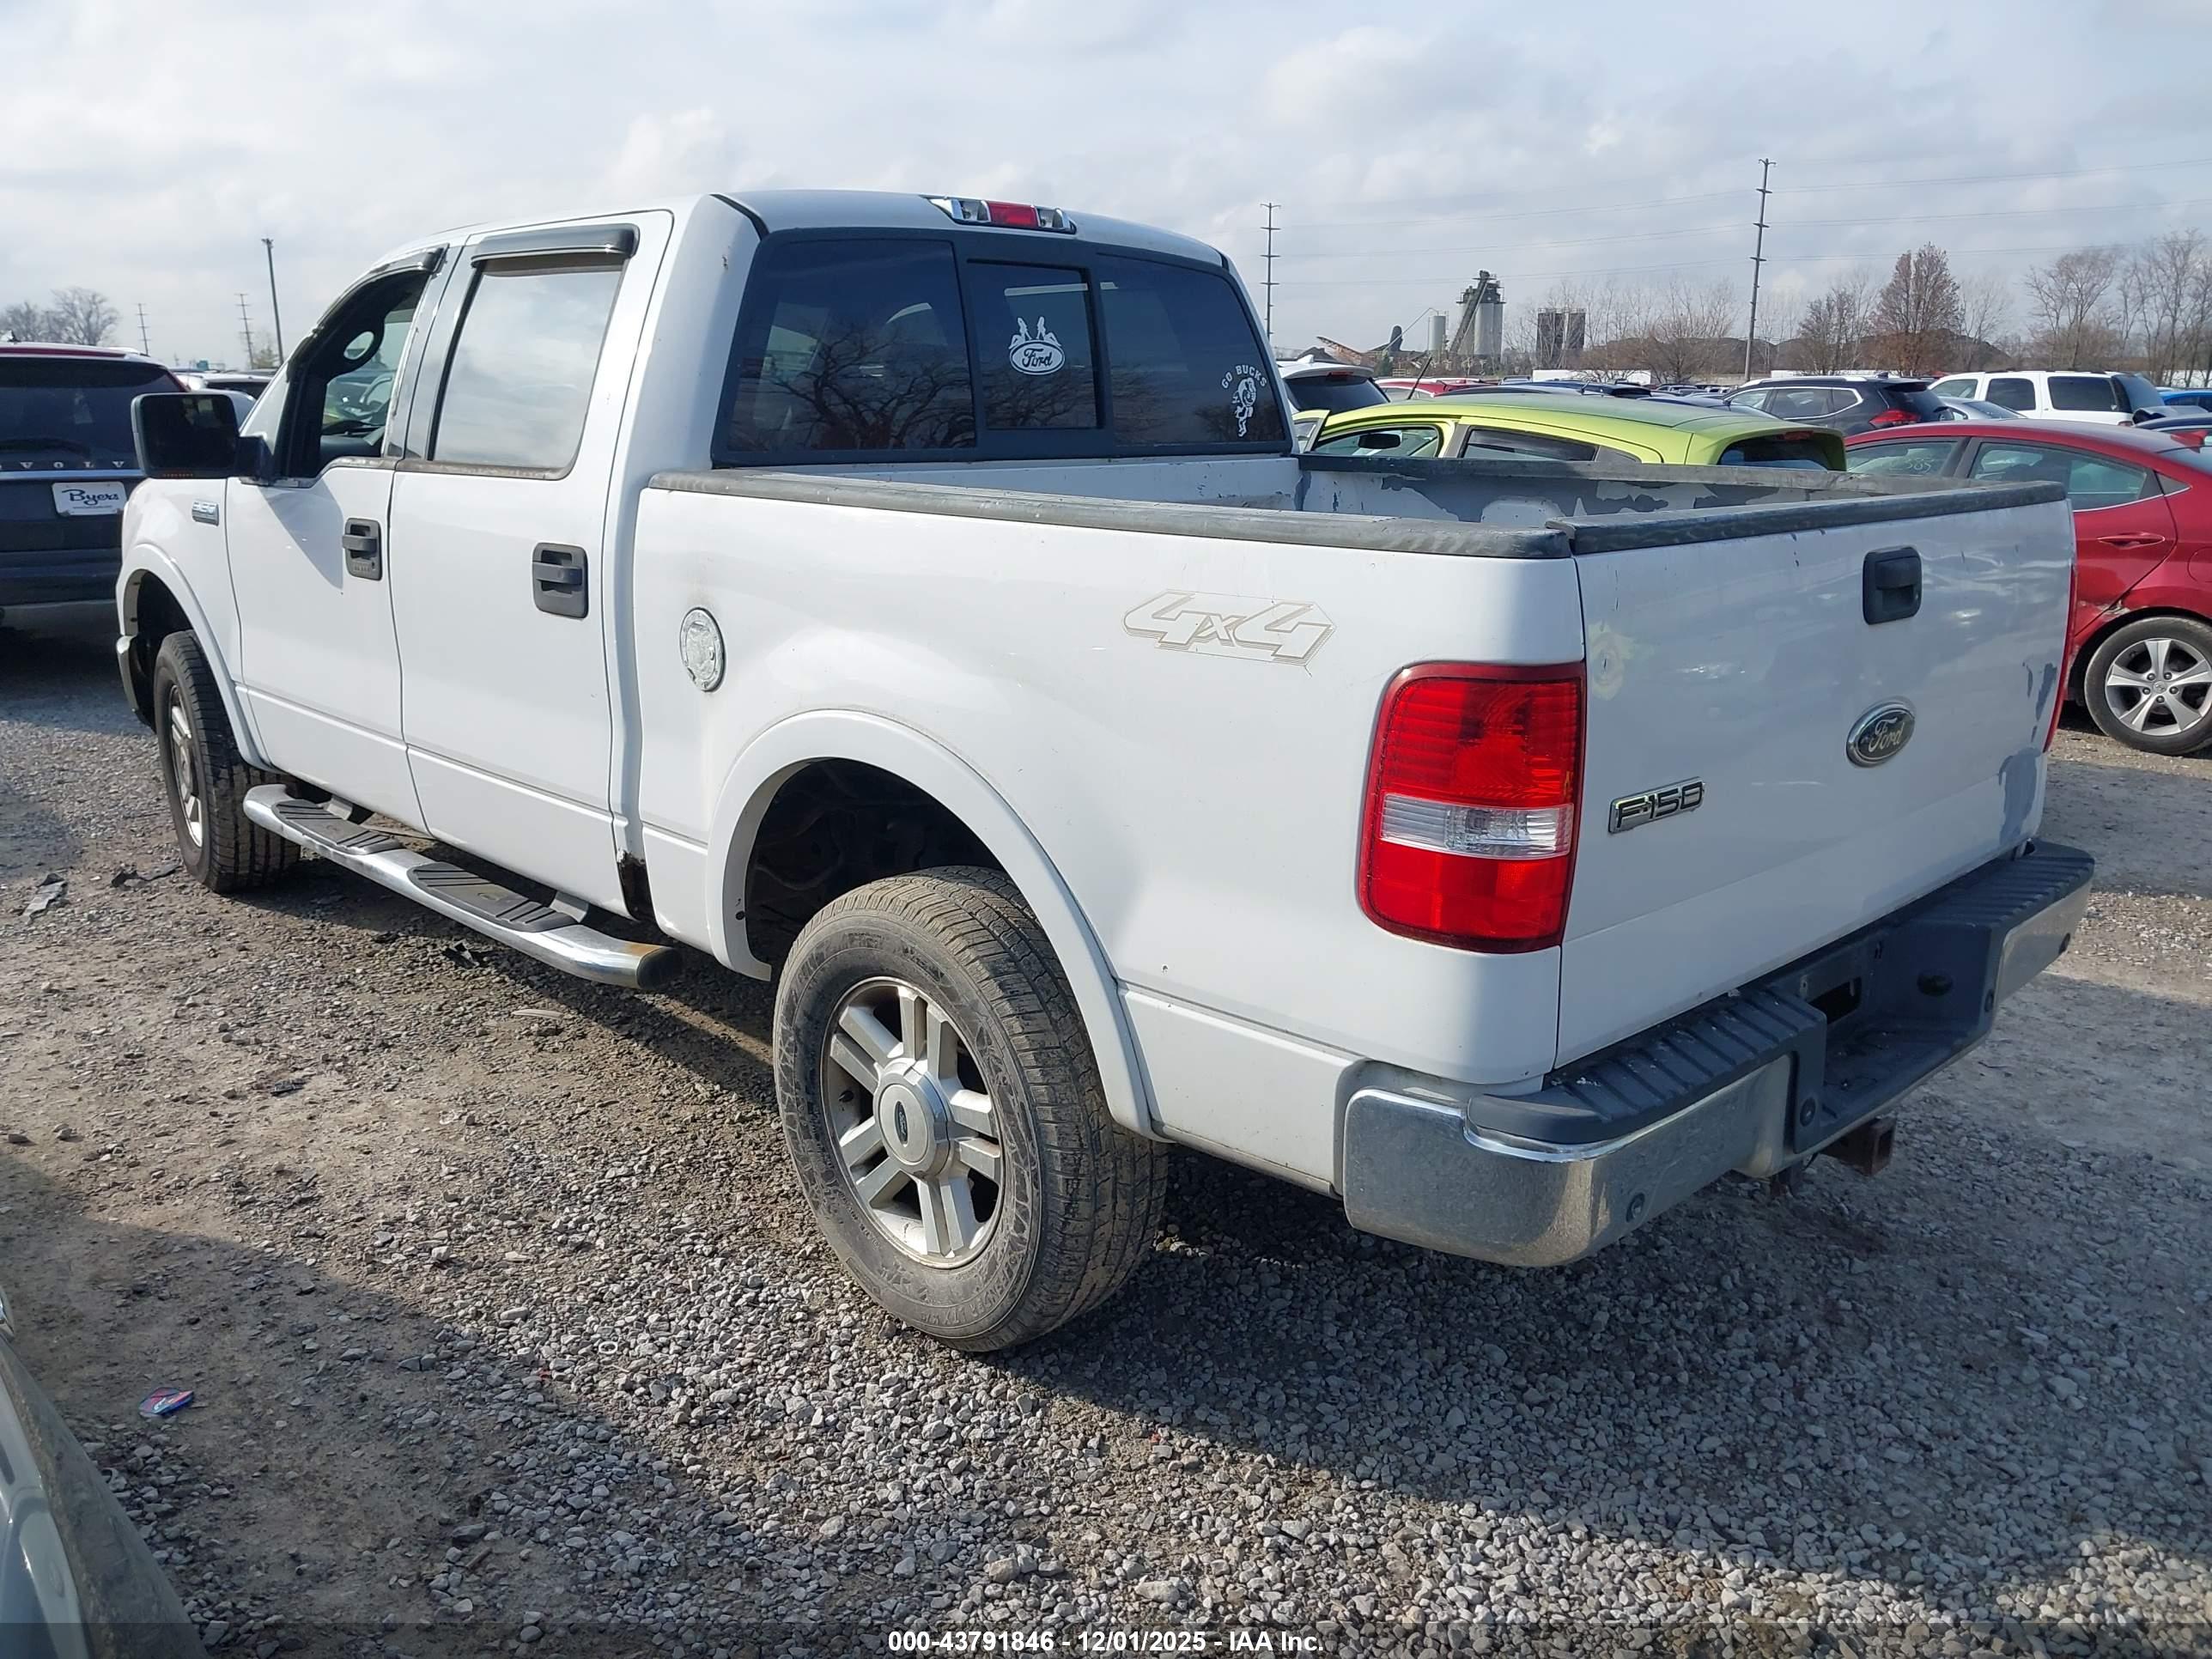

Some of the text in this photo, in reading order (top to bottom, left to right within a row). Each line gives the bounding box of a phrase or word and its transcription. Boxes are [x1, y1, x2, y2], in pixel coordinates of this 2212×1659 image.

[1021, 348, 1054, 368] Ford
[1221, 364, 1267, 389] GO BUCKS
[20, 460, 125, 470] VOLV
[61, 489, 119, 506] Byers
[1123, 591, 1334, 665] 4x4
[1868, 716, 1905, 752] Ford
